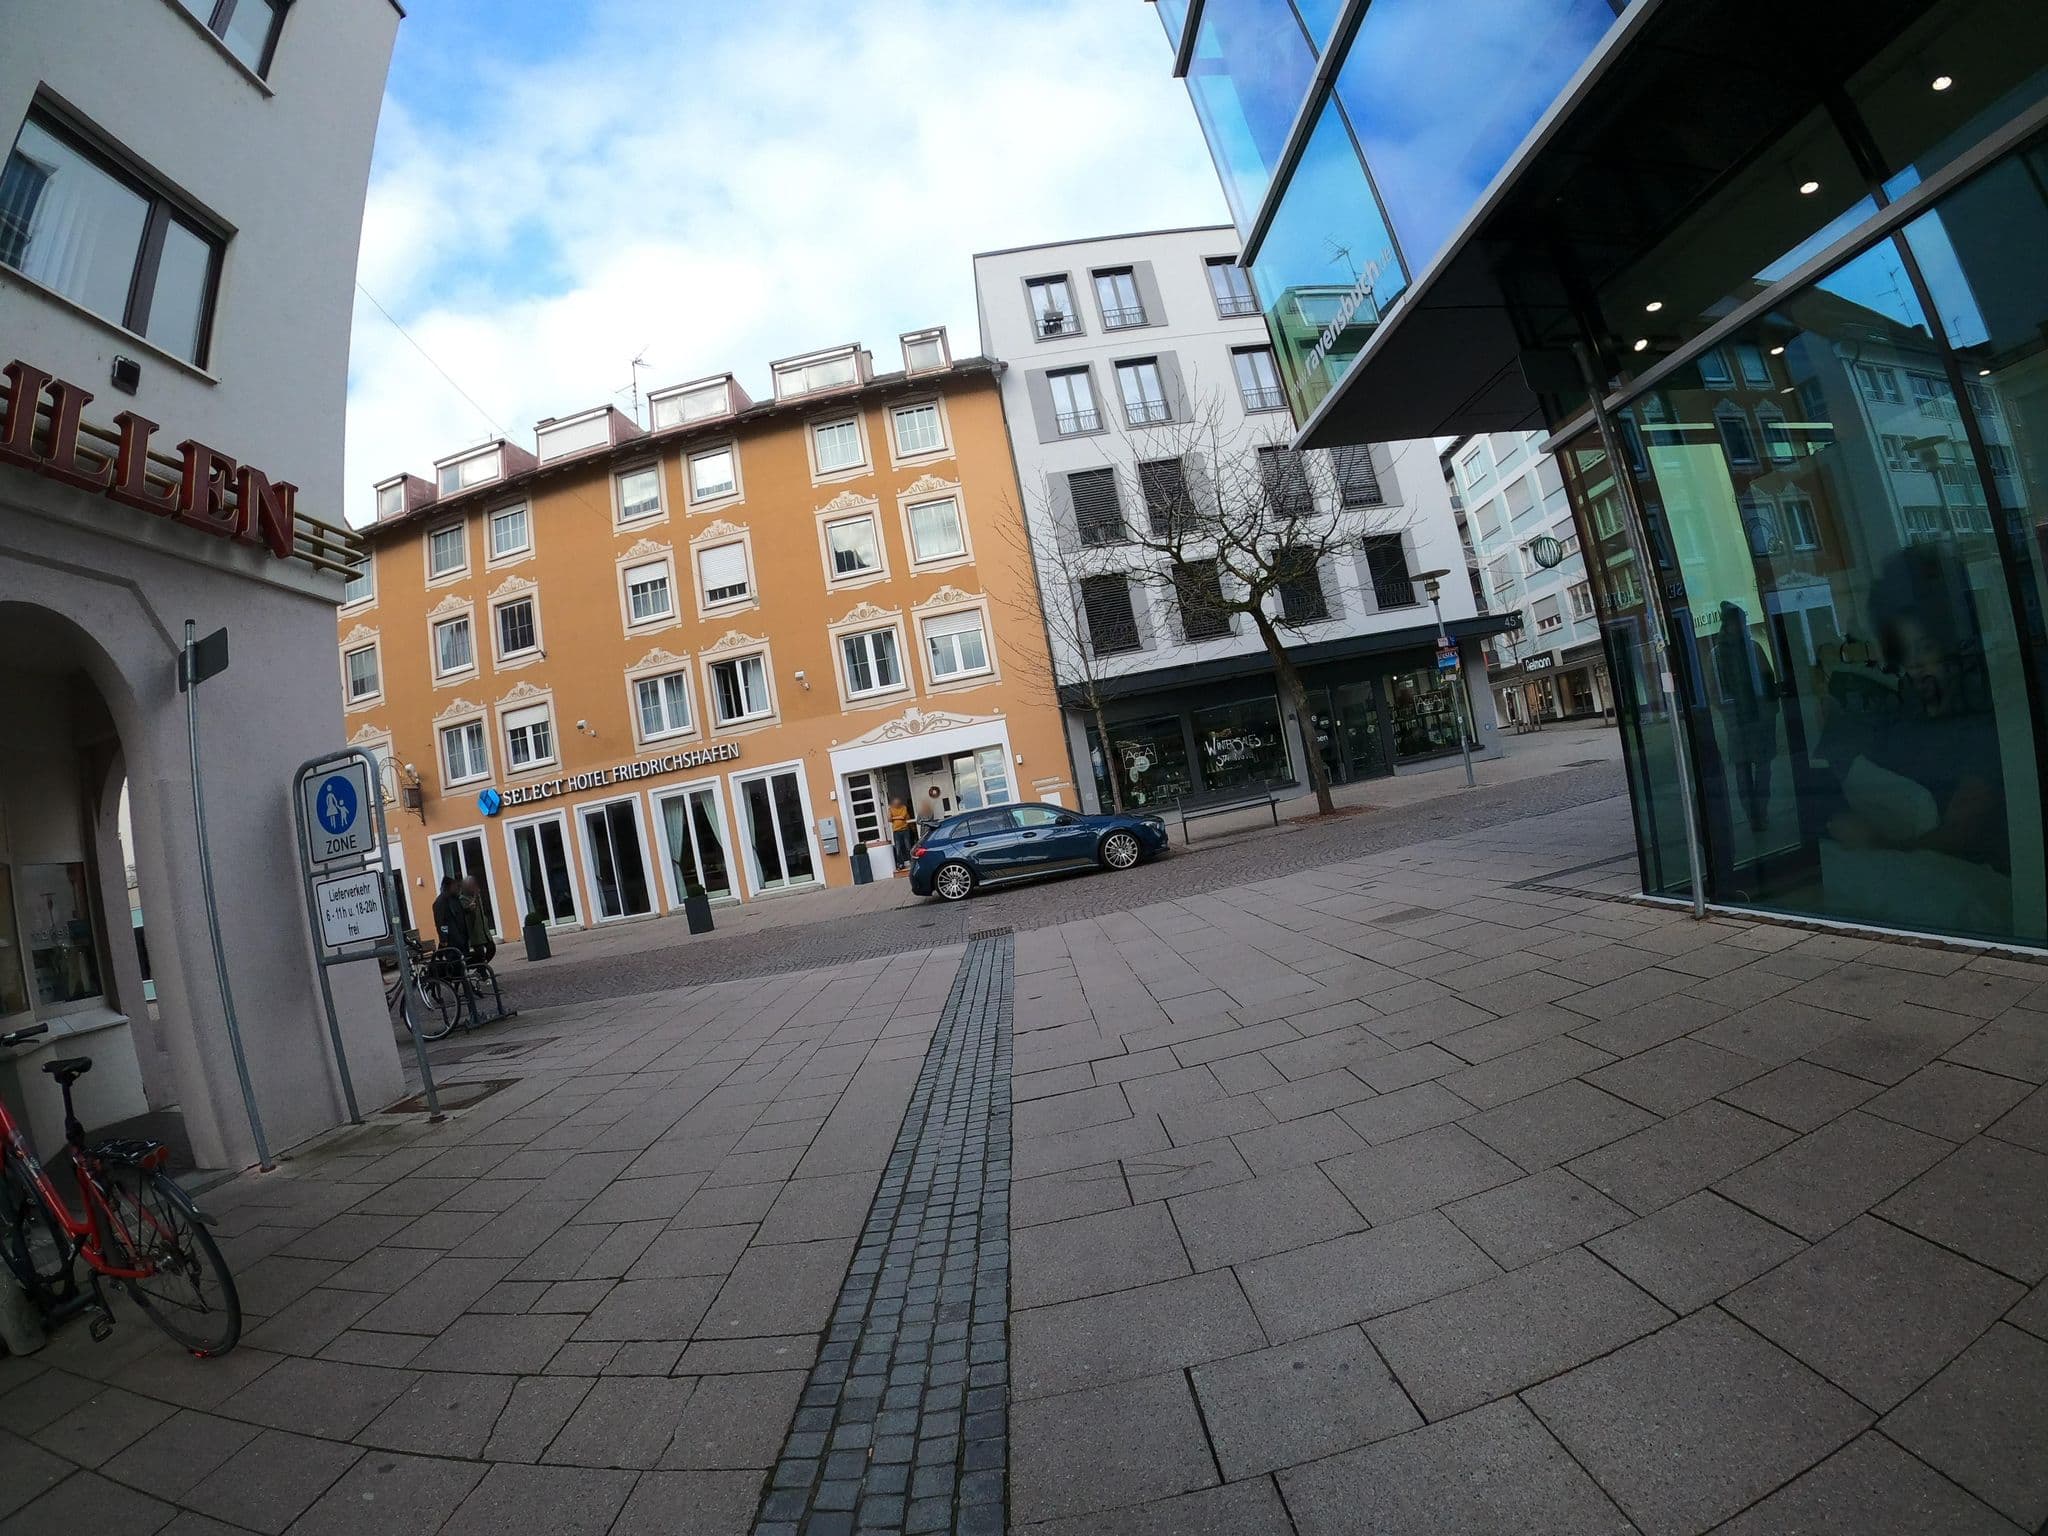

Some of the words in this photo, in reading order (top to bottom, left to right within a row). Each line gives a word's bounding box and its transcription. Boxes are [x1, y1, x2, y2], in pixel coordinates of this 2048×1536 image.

[503, 779, 564, 806] SELECT
[568, 772, 610, 792] HOTEL
[612, 742, 740, 783] FRIEDRICHSHAFEN
[326, 835, 358, 854] ZONE
[328, 882, 371, 902] Lieferverkehr
[355, 899, 378, 916] 18-20h
[347, 922, 360, 936] frei
